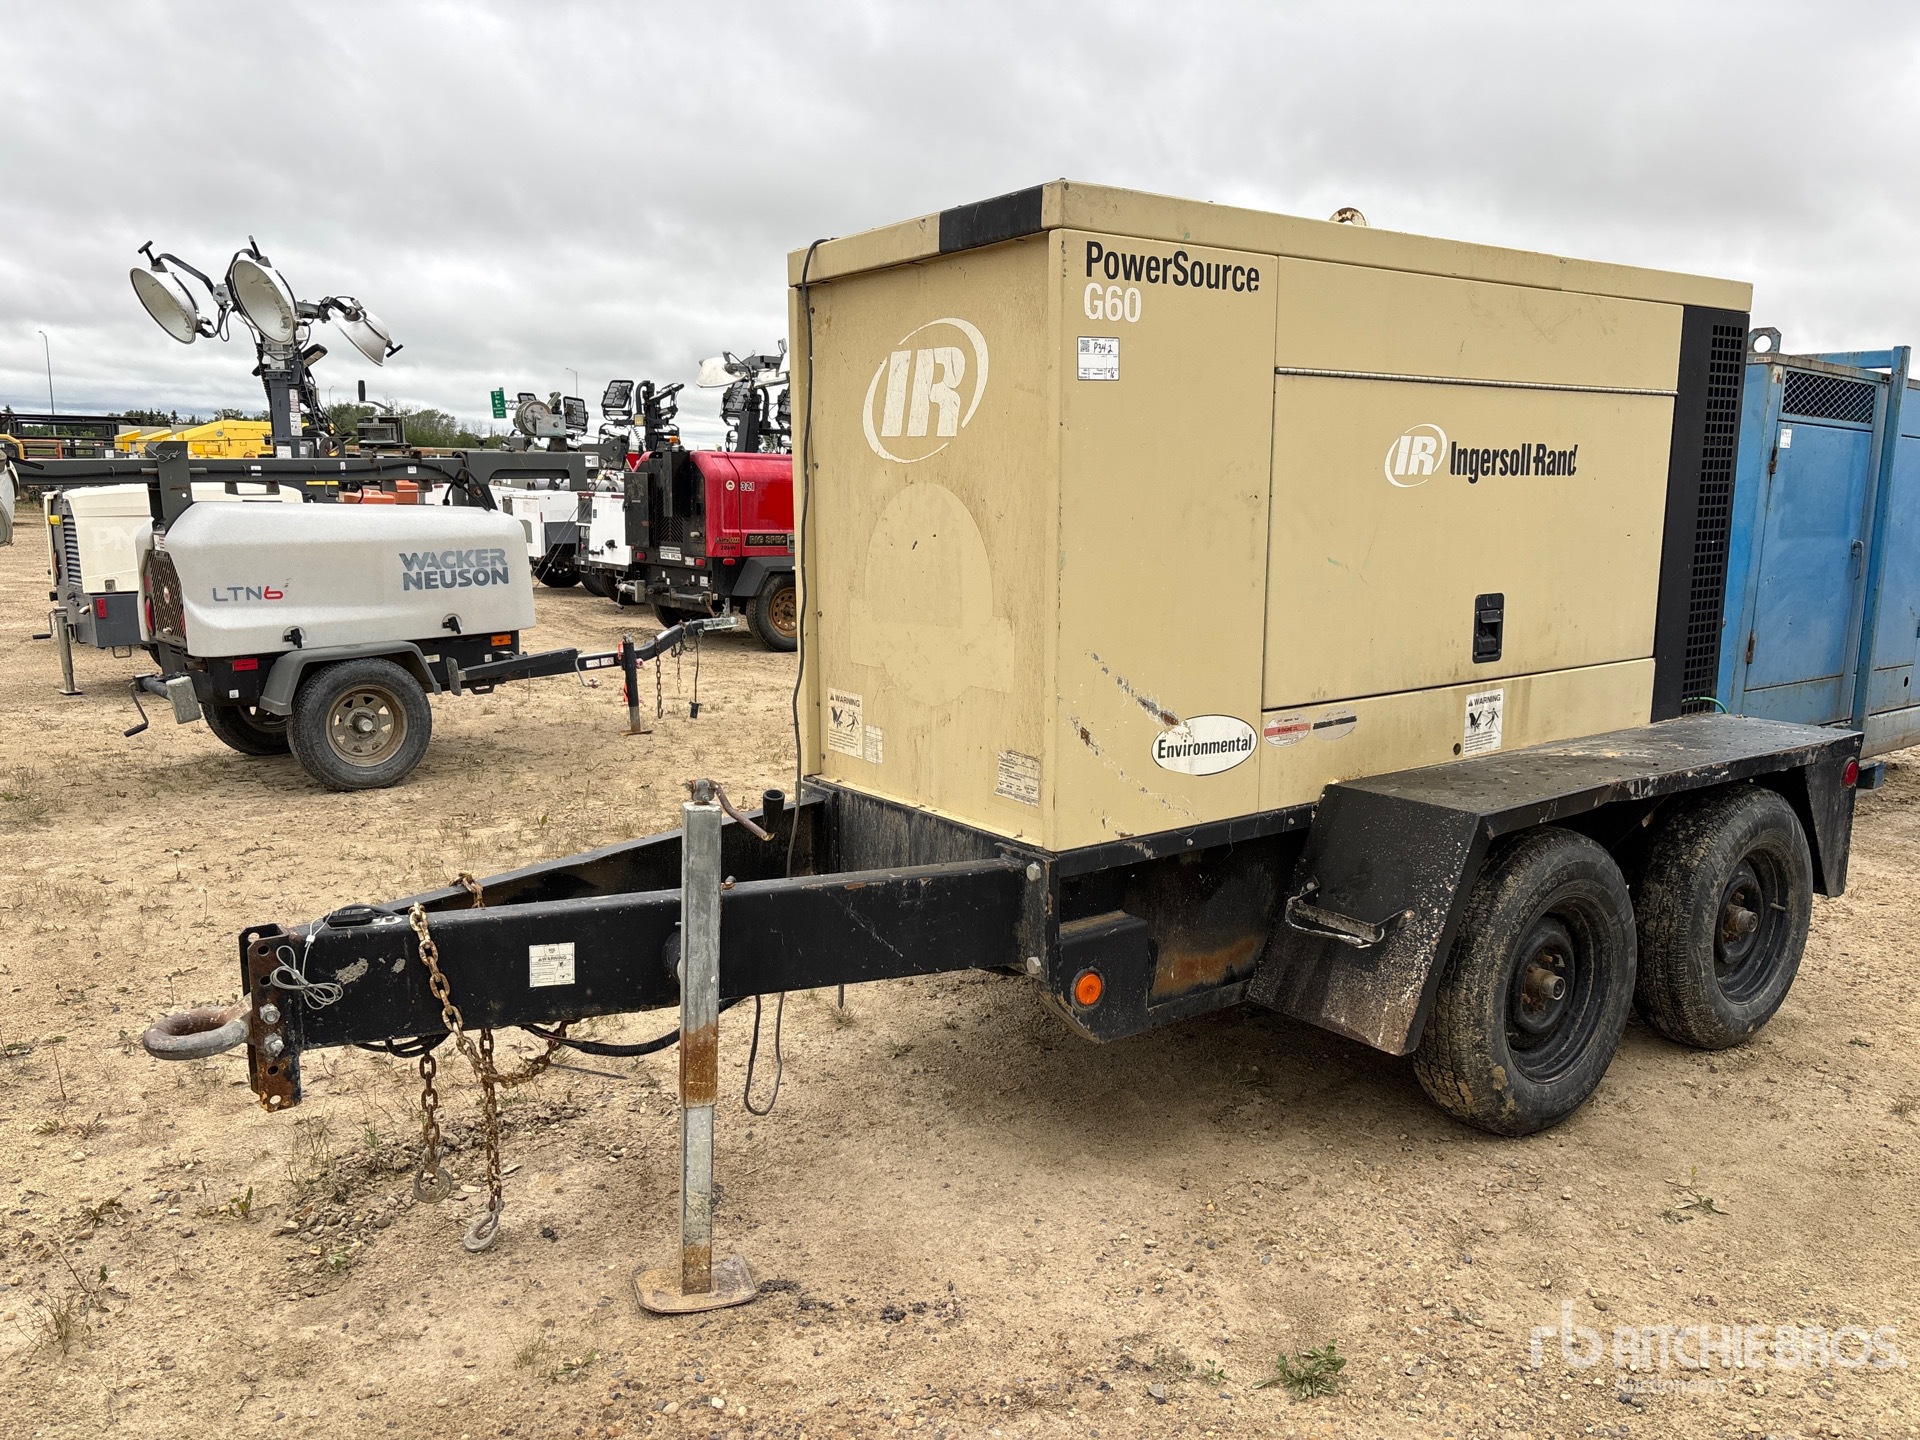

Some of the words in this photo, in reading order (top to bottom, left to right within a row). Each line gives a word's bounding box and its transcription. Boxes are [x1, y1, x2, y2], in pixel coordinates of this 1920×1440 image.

[1086, 241, 1260, 293] PowerSource
[1083, 282, 1142, 323] G60
[881, 347, 967, 438] IR
[1394, 435, 1438, 476] IR
[740, 481, 755, 492] 321
[399, 548, 508, 572] WACKER
[402, 566, 509, 591] NEUSON
[212, 585, 284, 602] LTN6
[835, 694, 861, 708] WARNING
[1474, 694, 1502, 706] WARNING
[1157, 733, 1252, 759] Environmental
